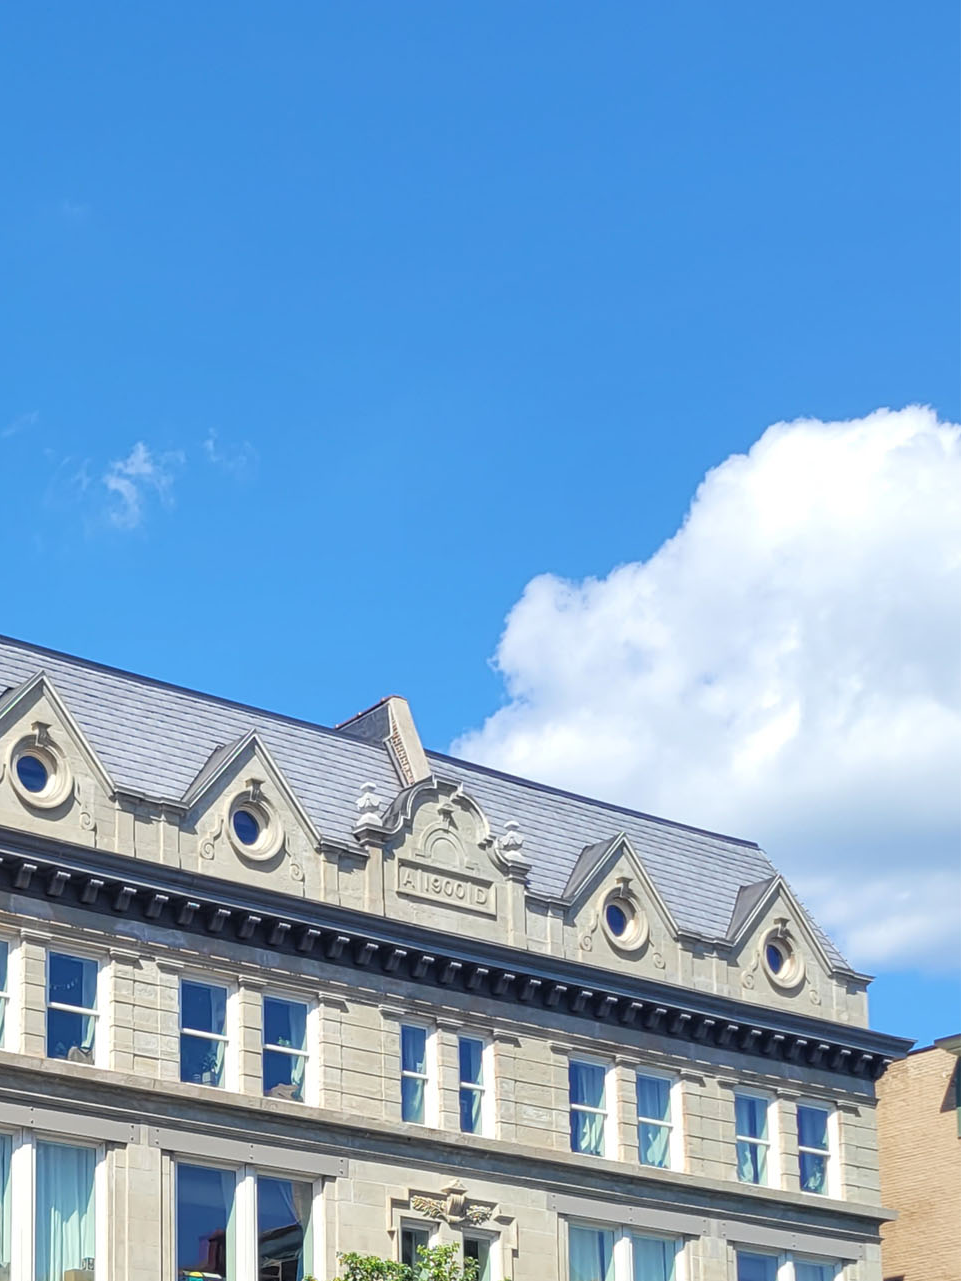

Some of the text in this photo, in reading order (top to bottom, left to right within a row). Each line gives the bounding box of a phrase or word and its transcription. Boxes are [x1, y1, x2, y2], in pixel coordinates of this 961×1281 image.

[402, 869, 488, 905] A 1900 D
